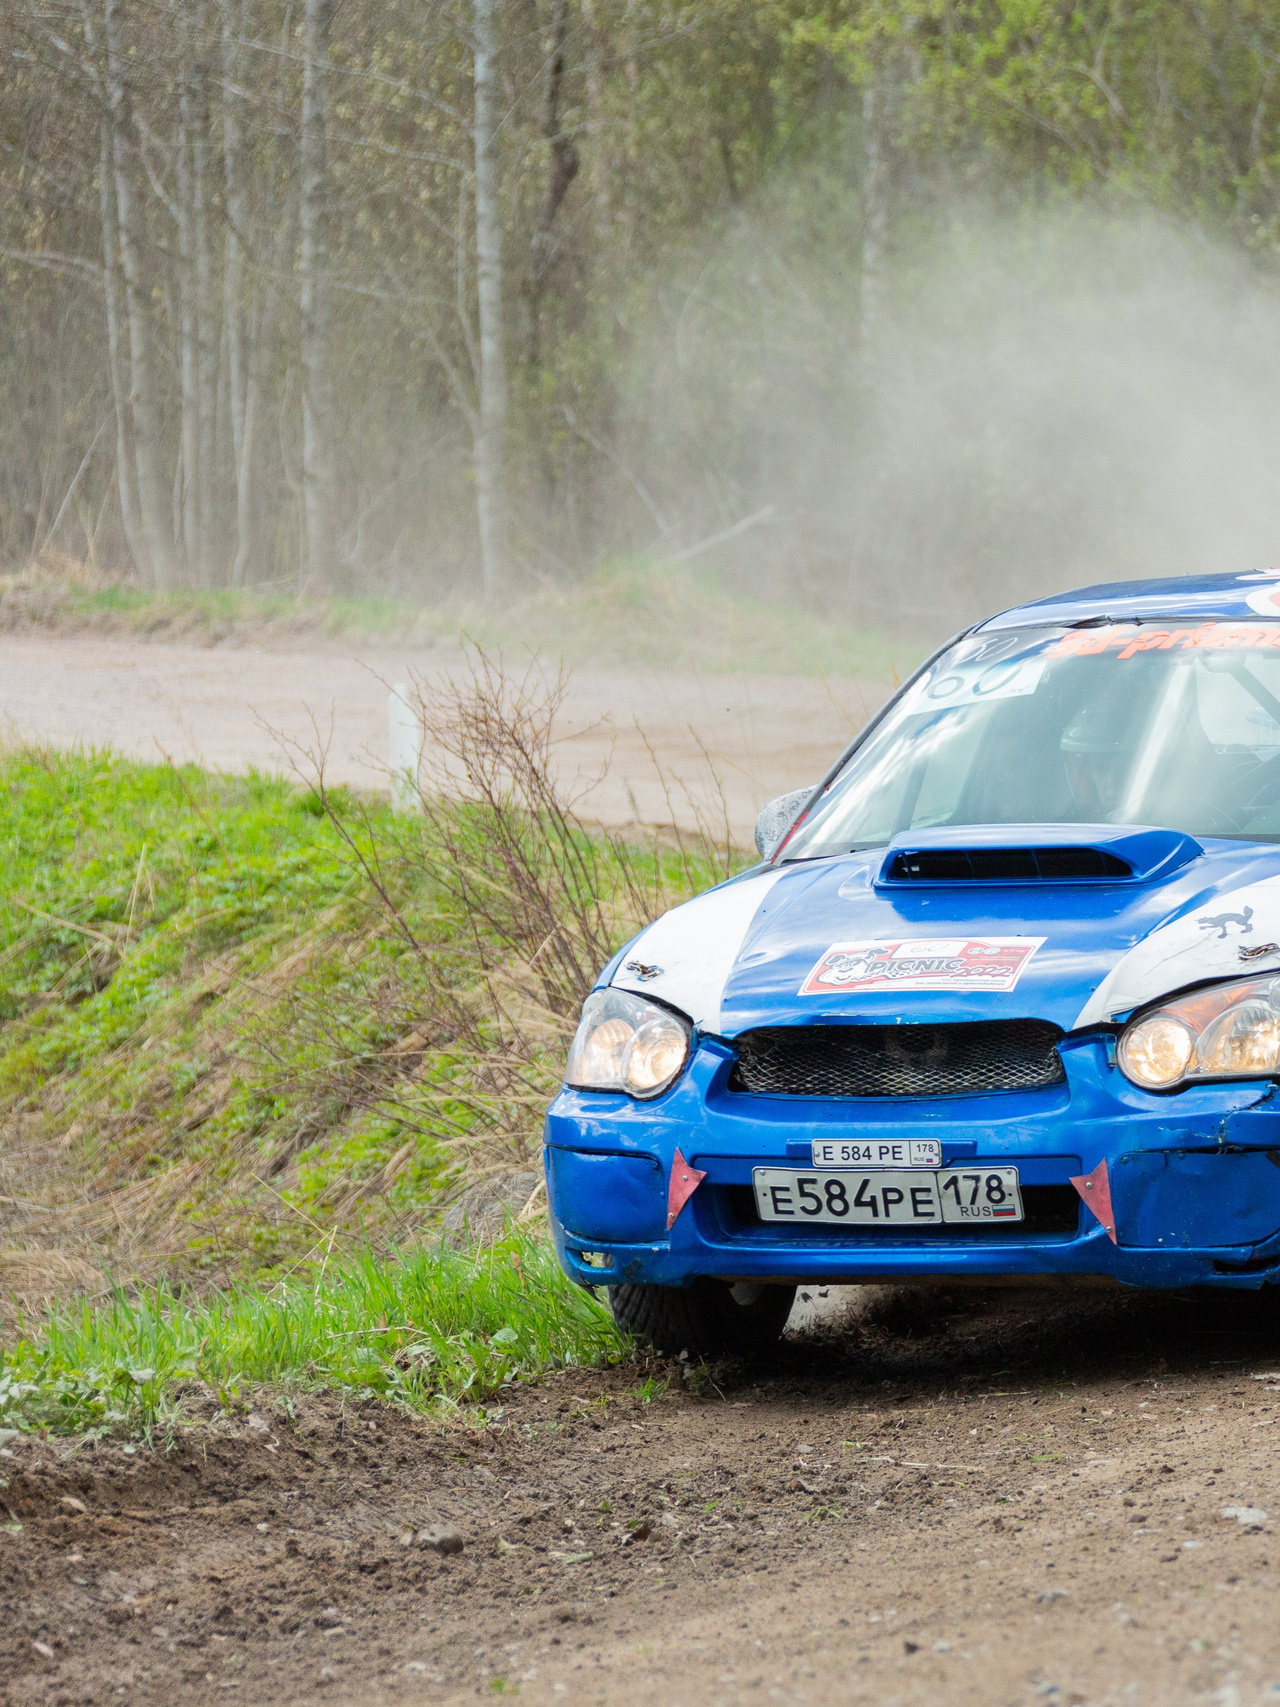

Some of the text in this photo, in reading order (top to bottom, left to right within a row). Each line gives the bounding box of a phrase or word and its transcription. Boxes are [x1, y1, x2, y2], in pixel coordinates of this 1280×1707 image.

[864, 958, 966, 974] PICNIC
[949, 965, 1014, 978] 2022
[841, 1145, 872, 1161] 584
[916, 1143, 934, 1153] 178
[942, 1173, 1006, 1206] 178
[960, 1206, 992, 1217] RUS
